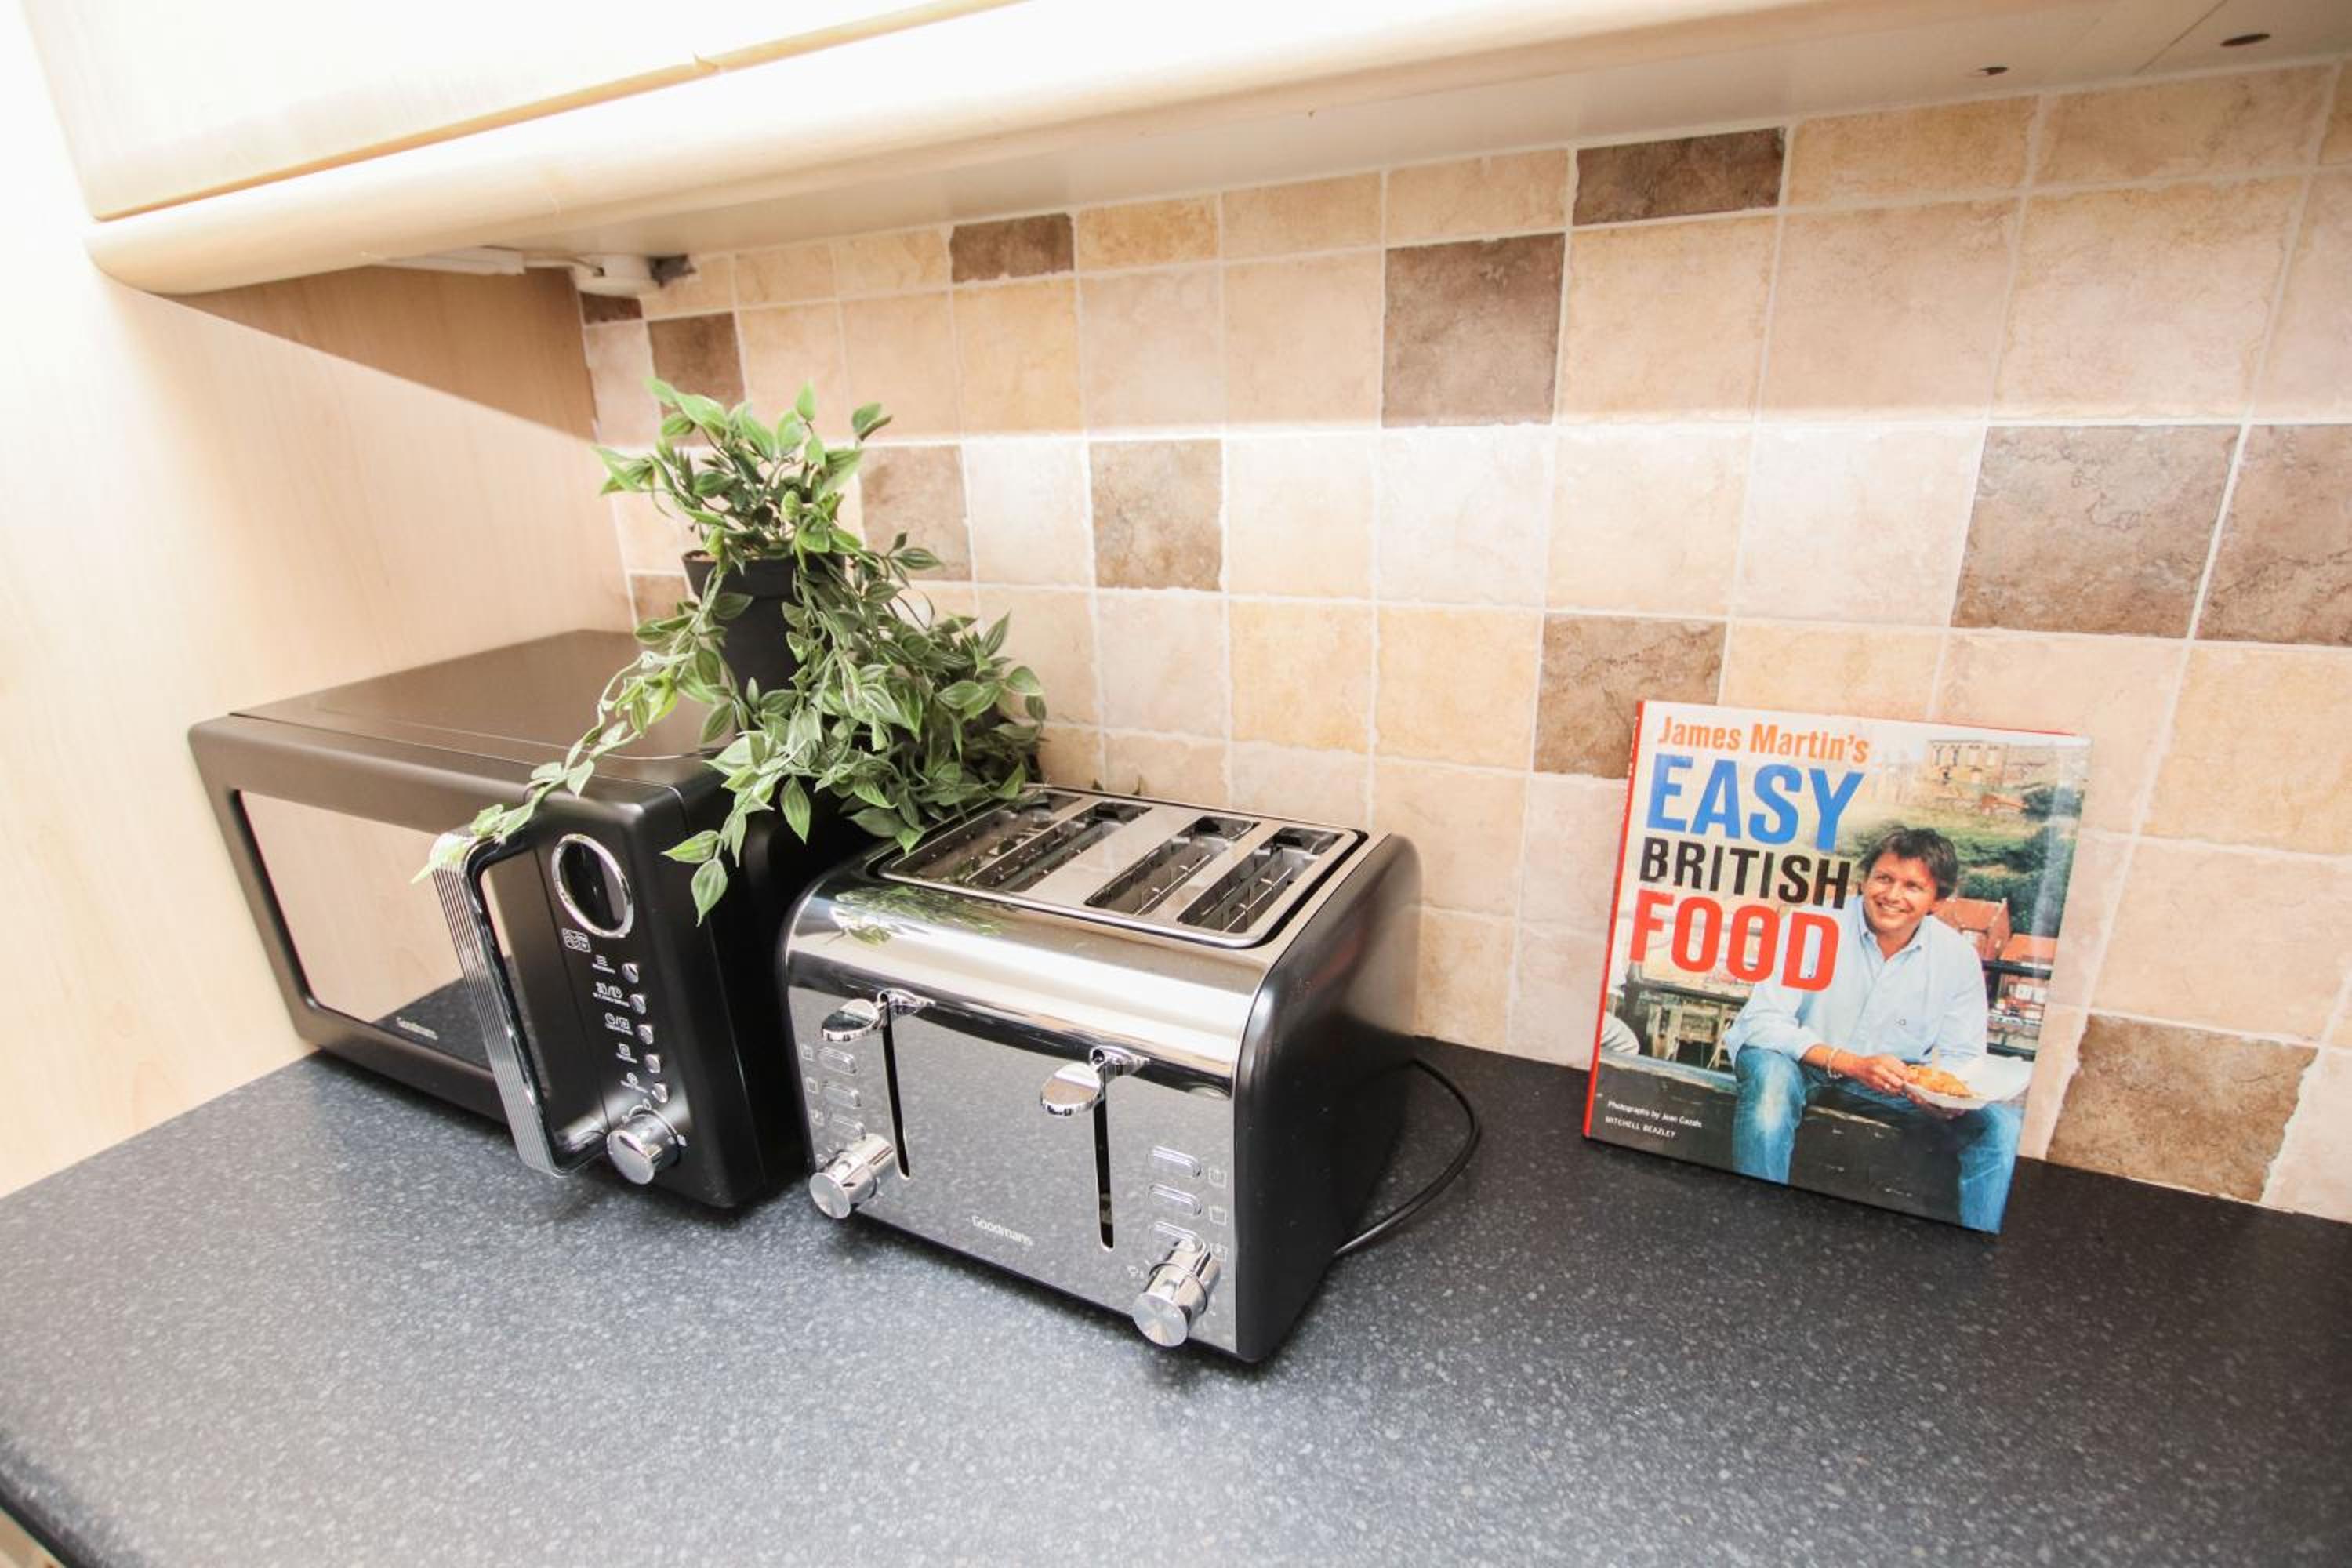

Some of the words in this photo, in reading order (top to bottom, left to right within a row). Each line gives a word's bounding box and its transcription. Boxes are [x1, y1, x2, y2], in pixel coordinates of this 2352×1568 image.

[1657, 715, 1742, 751] James
[1749, 723, 1870, 764] Martin's
[1646, 753, 1865, 853] EASY
[1639, 837, 1851, 910] BRITISH
[1629, 888, 1840, 993] FOOD
[1605, 1116, 1640, 1130] MITCHELL
[1642, 1125, 1675, 1138] BEAZLEY
[1650, 1110, 1661, 1120] by
[971, 1215, 1033, 1247] Goodmans
